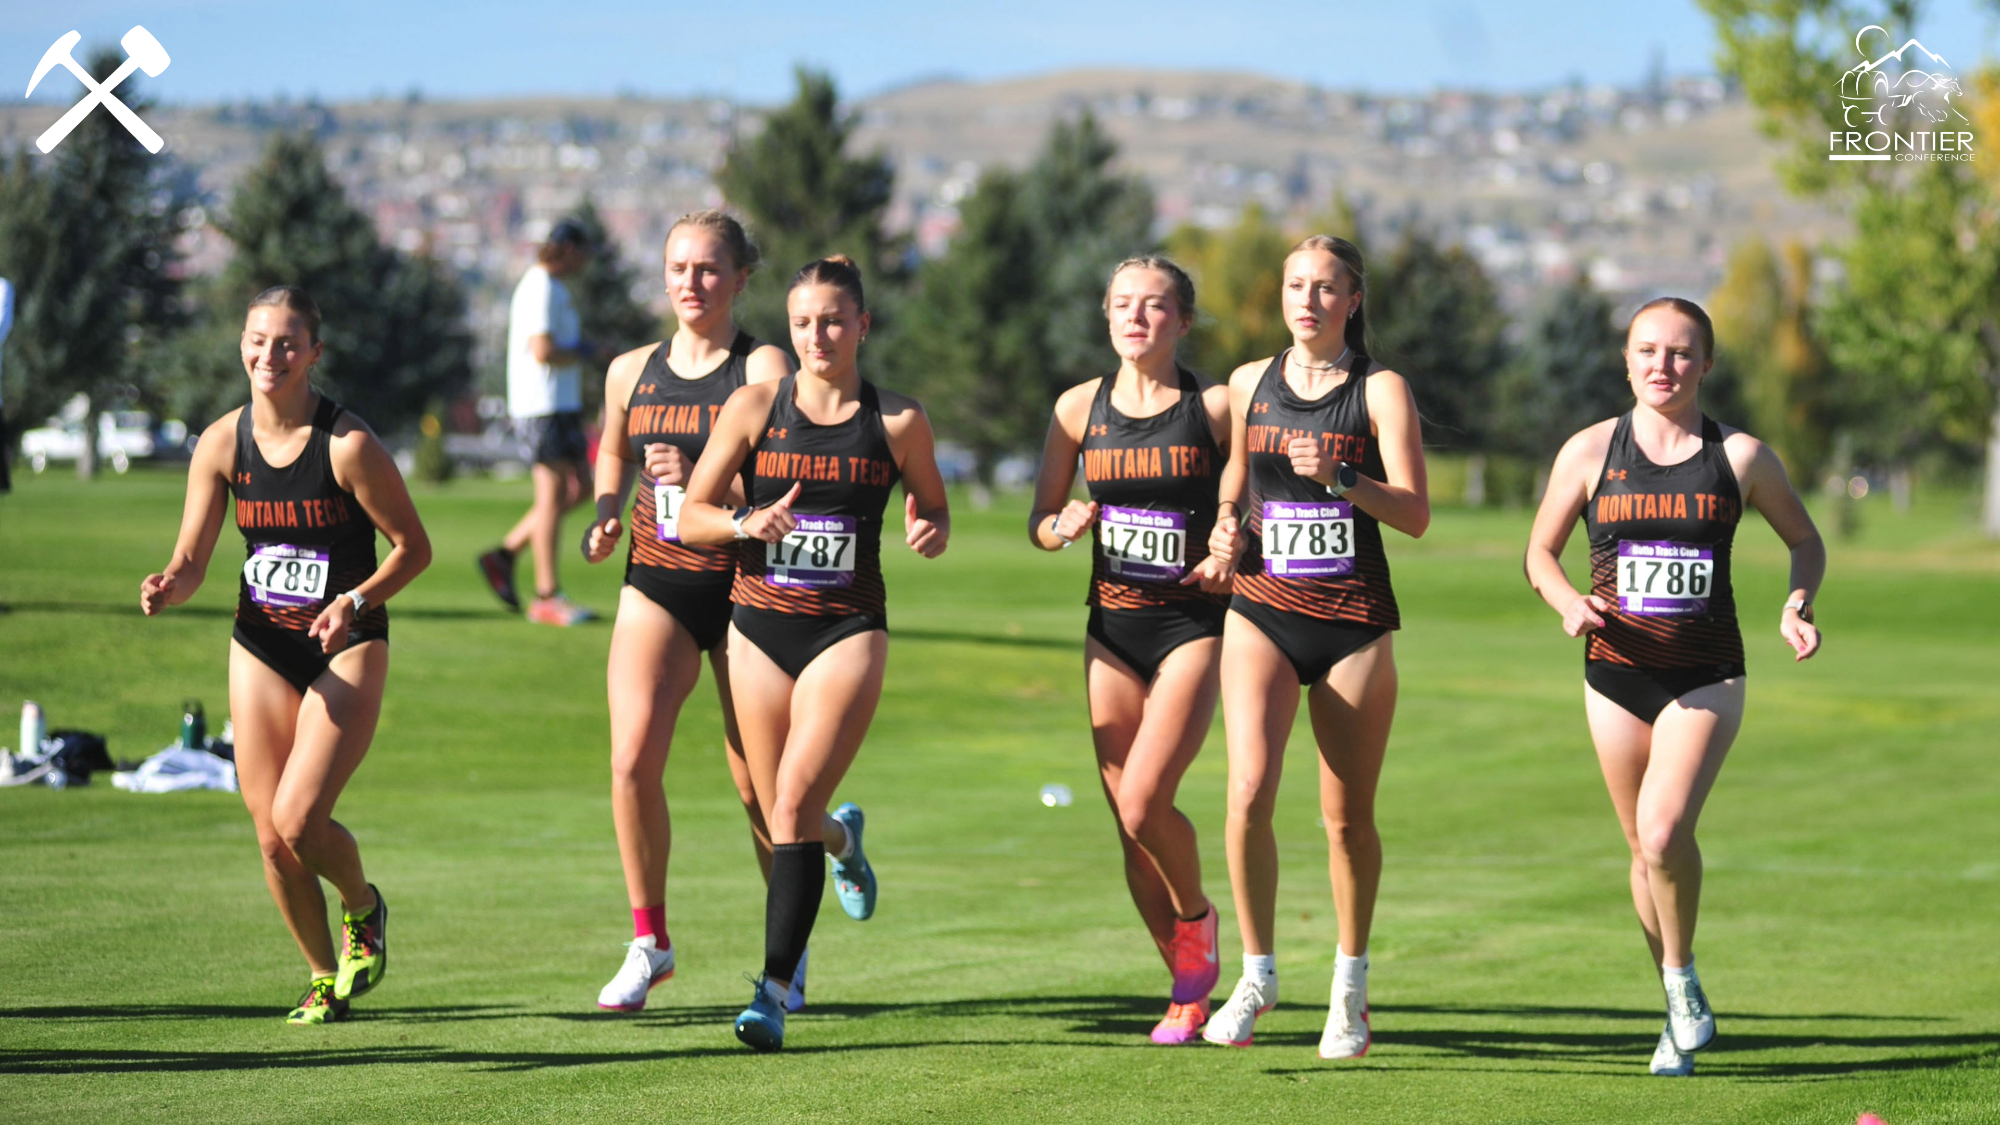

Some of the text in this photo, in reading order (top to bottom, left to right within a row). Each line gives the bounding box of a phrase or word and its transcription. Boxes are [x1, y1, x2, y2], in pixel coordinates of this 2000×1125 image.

[1247, 424, 1366, 464] ONTA TECH
[755, 450, 890, 487] MONTANA TECH
[1085, 445, 1211, 482] MONTANA TECH
[303, 496, 349, 528] TECH
[800, 519, 823, 532] Track
[824, 521, 845, 532] Club
[1319, 507, 1340, 518] Club
[1597, 493, 1738, 525] MONTANA TECH
[771, 534, 851, 569] 1787
[1107, 525, 1181, 564] 1790
[1270, 521, 1349, 556] 1783
[1679, 546, 1700, 558] Club
[252, 559, 323, 594] 1789
[1625, 560, 1708, 596] 1786
